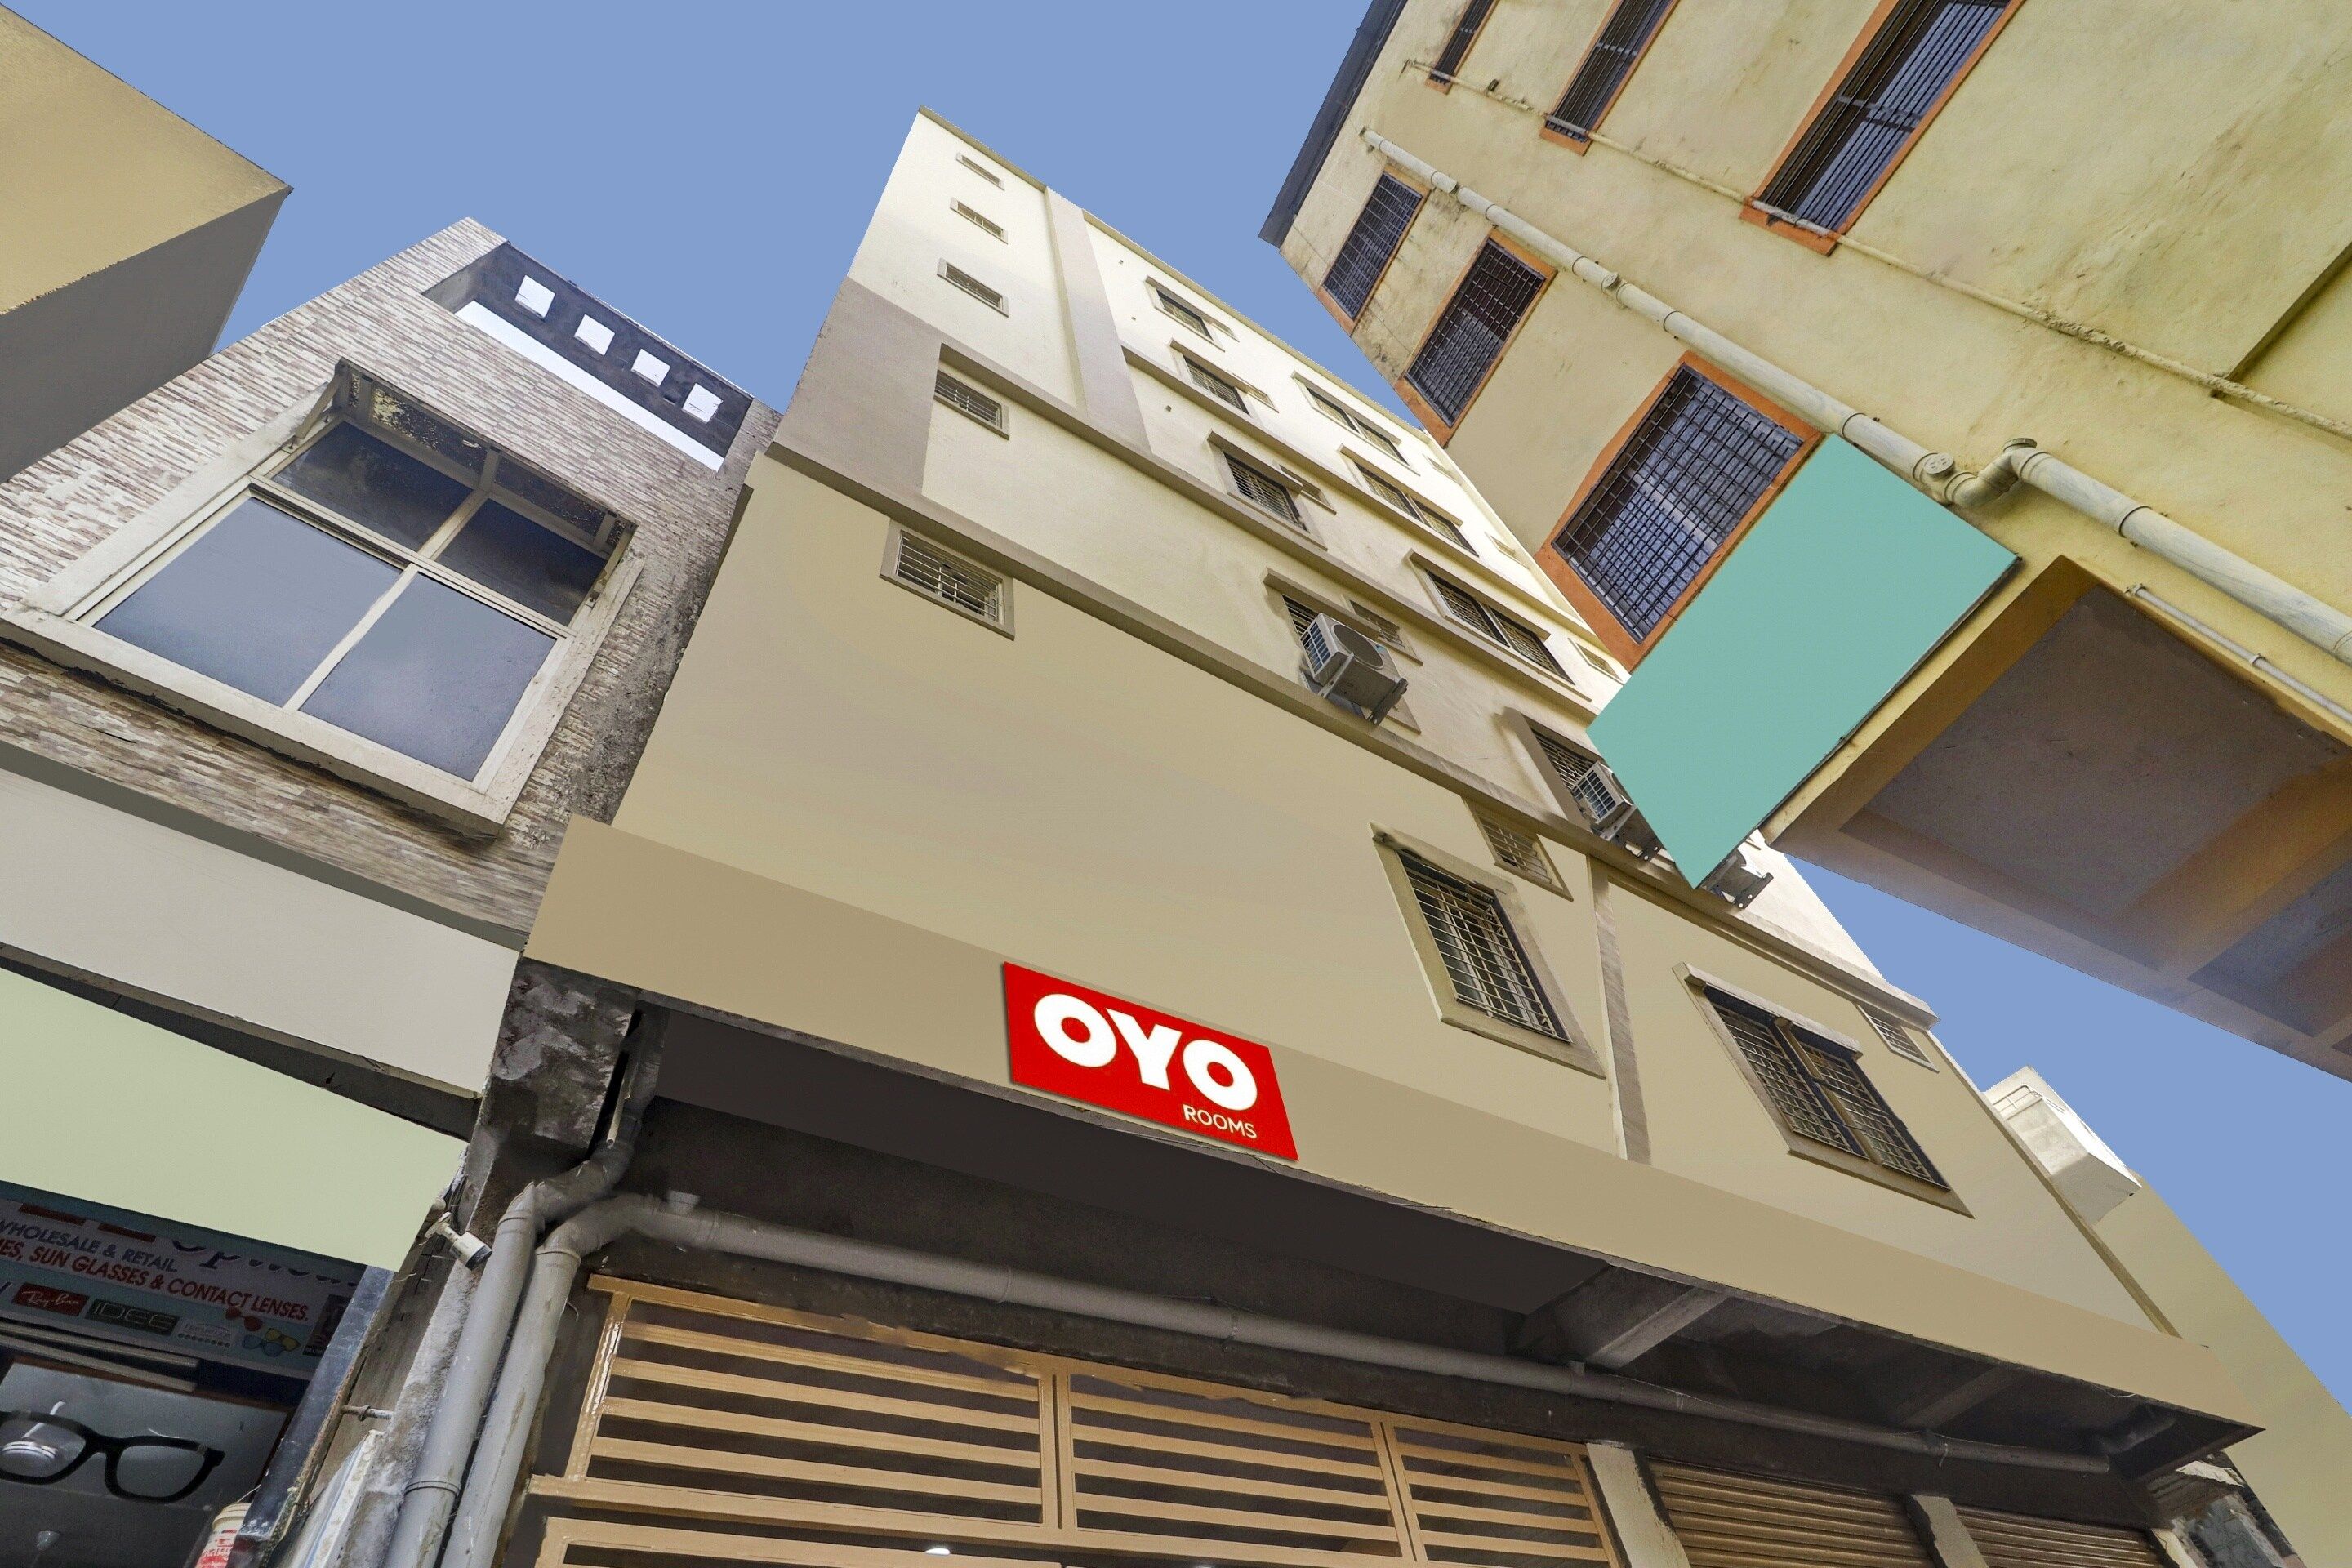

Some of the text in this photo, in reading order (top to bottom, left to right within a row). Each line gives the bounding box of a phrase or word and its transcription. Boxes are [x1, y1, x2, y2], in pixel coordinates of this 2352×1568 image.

[1034, 993, 1258, 1111] OYO
[1183, 1104, 1257, 1138] ROOMS
[102, 1244, 117, 1258] &
[29, 1246, 71, 1268] SUN
[72, 1255, 149, 1285] GLASSES
[150, 1274, 165, 1290] &
[167, 1278, 252, 1308] CONTACT
[251, 1297, 309, 1321] LENSES.
